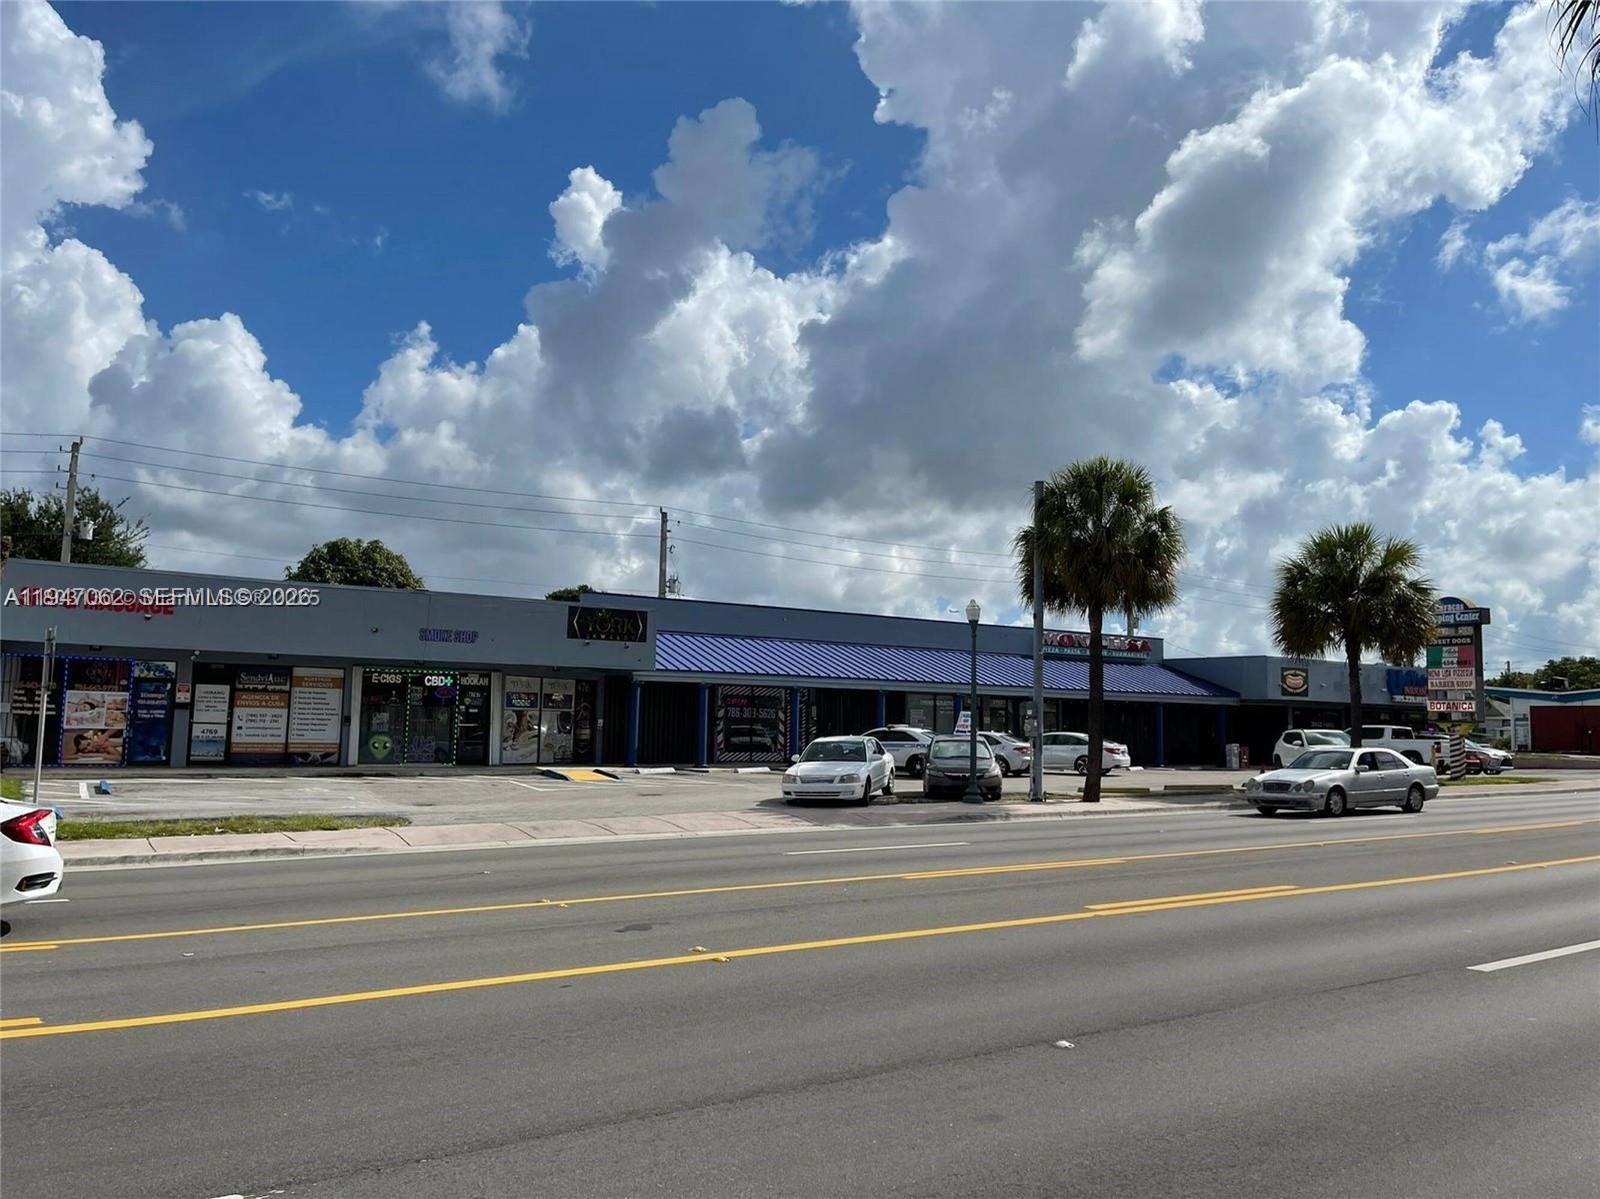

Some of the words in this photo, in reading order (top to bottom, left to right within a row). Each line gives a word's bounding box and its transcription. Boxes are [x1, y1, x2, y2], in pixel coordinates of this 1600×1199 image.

[418, 628, 453, 643] SMOKE
[453, 630, 480, 644] SHOP
[371, 672, 402, 684] E-CIGS
[1429, 701, 1473, 710] BOTANICA
